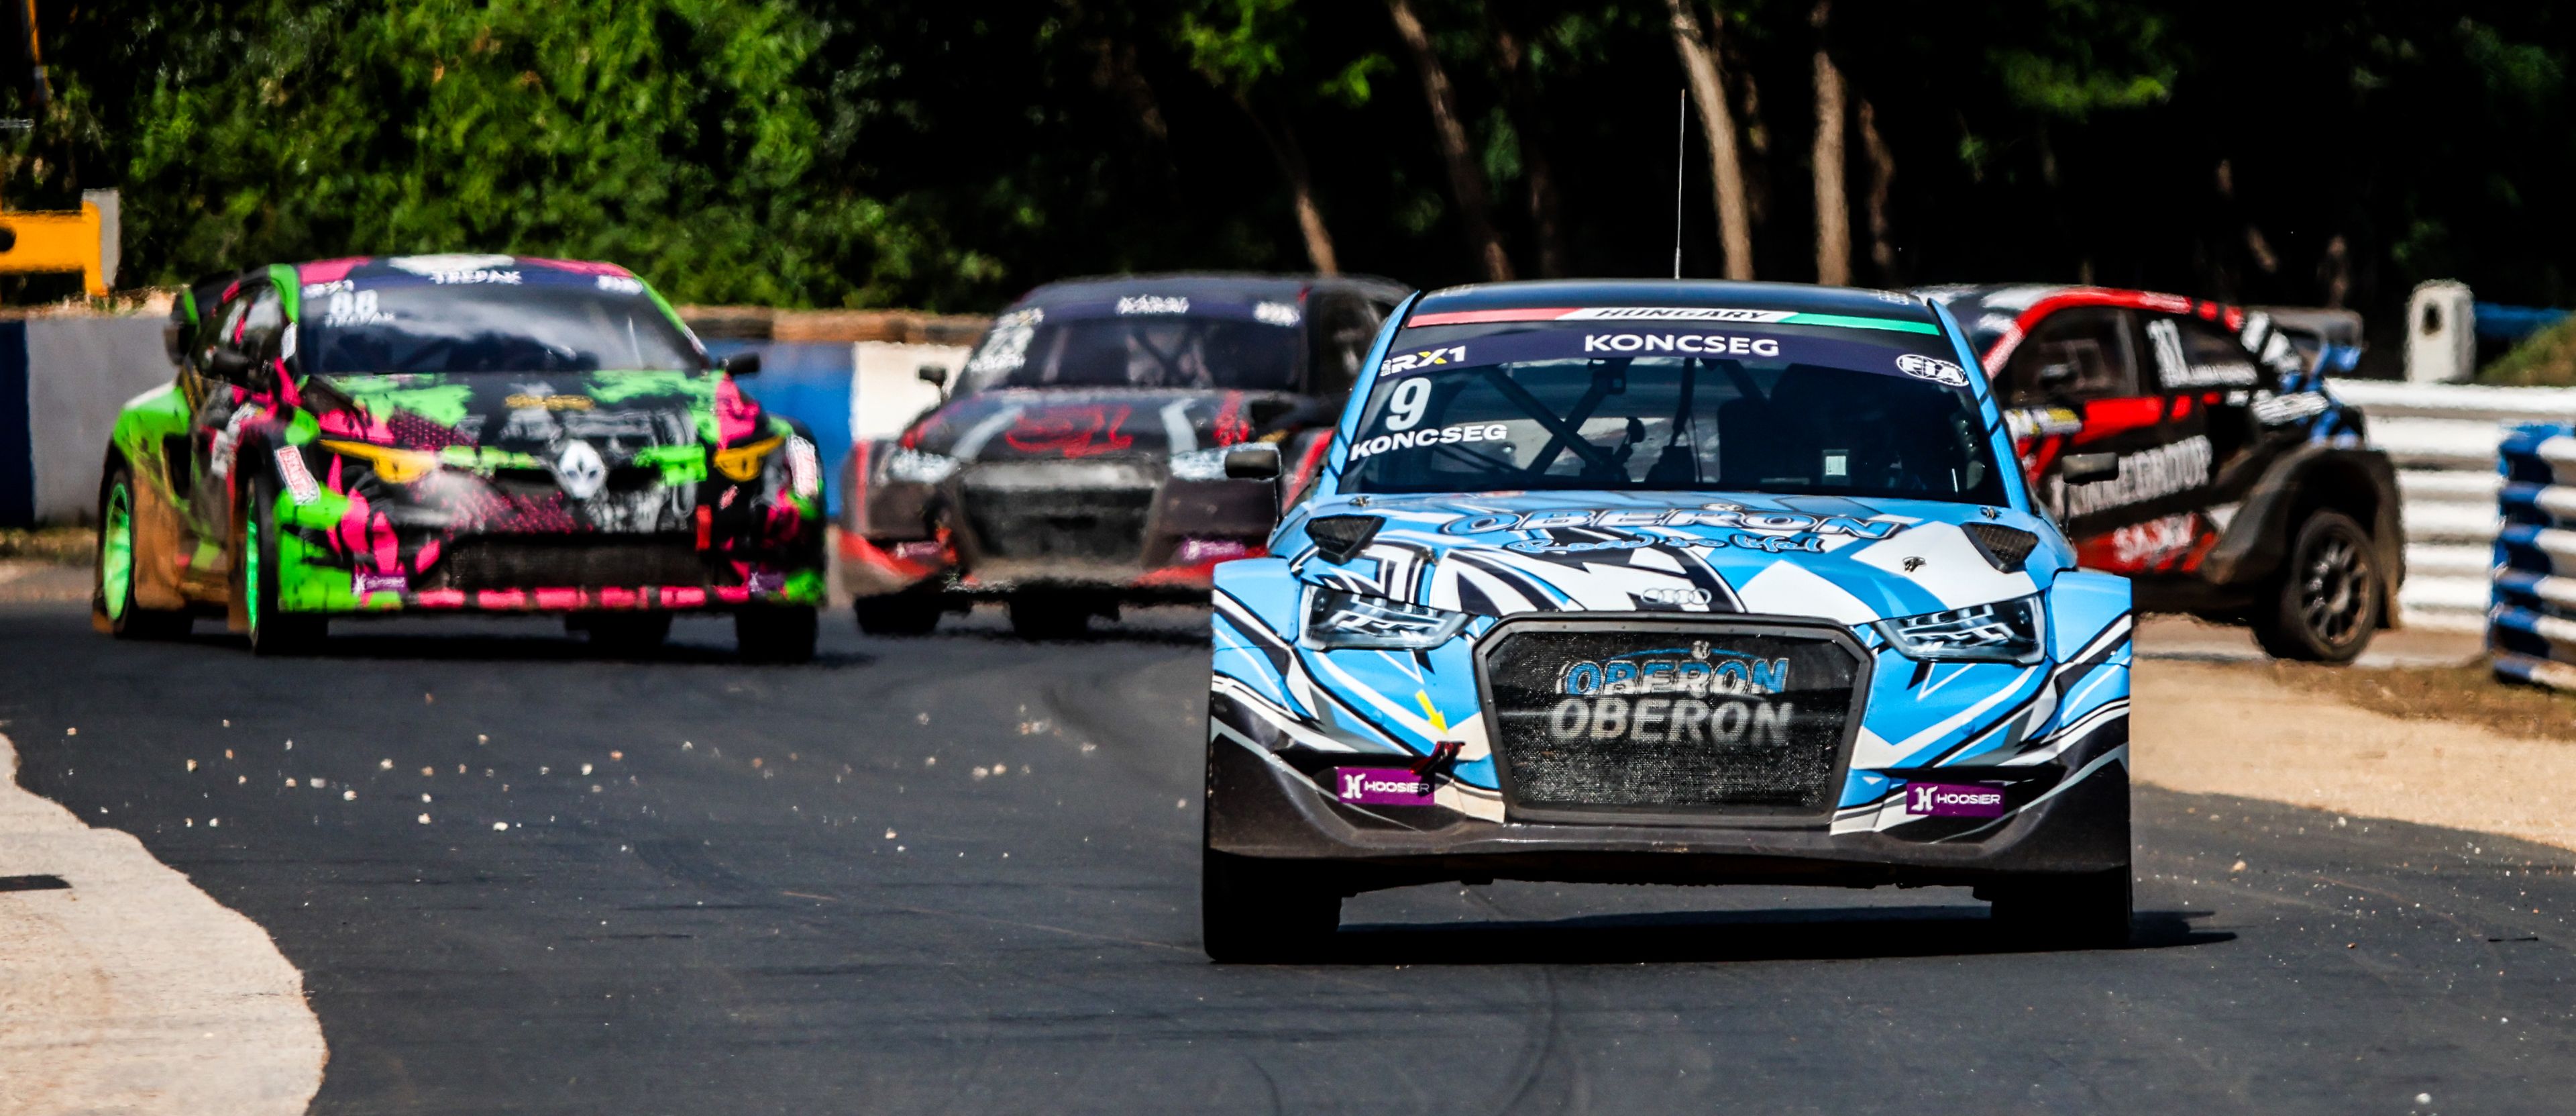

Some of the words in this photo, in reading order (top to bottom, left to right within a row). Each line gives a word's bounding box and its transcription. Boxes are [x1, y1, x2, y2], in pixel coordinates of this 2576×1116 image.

[429, 269, 522, 285] TREPAK
[1595, 309, 1770, 319] HUNGARY
[1391, 345, 1466, 374] RX1
[1585, 334, 1779, 356] KONCSEG
[1385, 377, 1432, 431] 9
[1349, 424, 1507, 461] KONCSEG
[1443, 509, 1901, 539] OBERON
[1563, 658, 1789, 697] OBERON
[1550, 698, 1794, 746] OBERON
[1364, 781, 1430, 793] HOOSIER
[1935, 794, 2001, 805] HOOSIER
